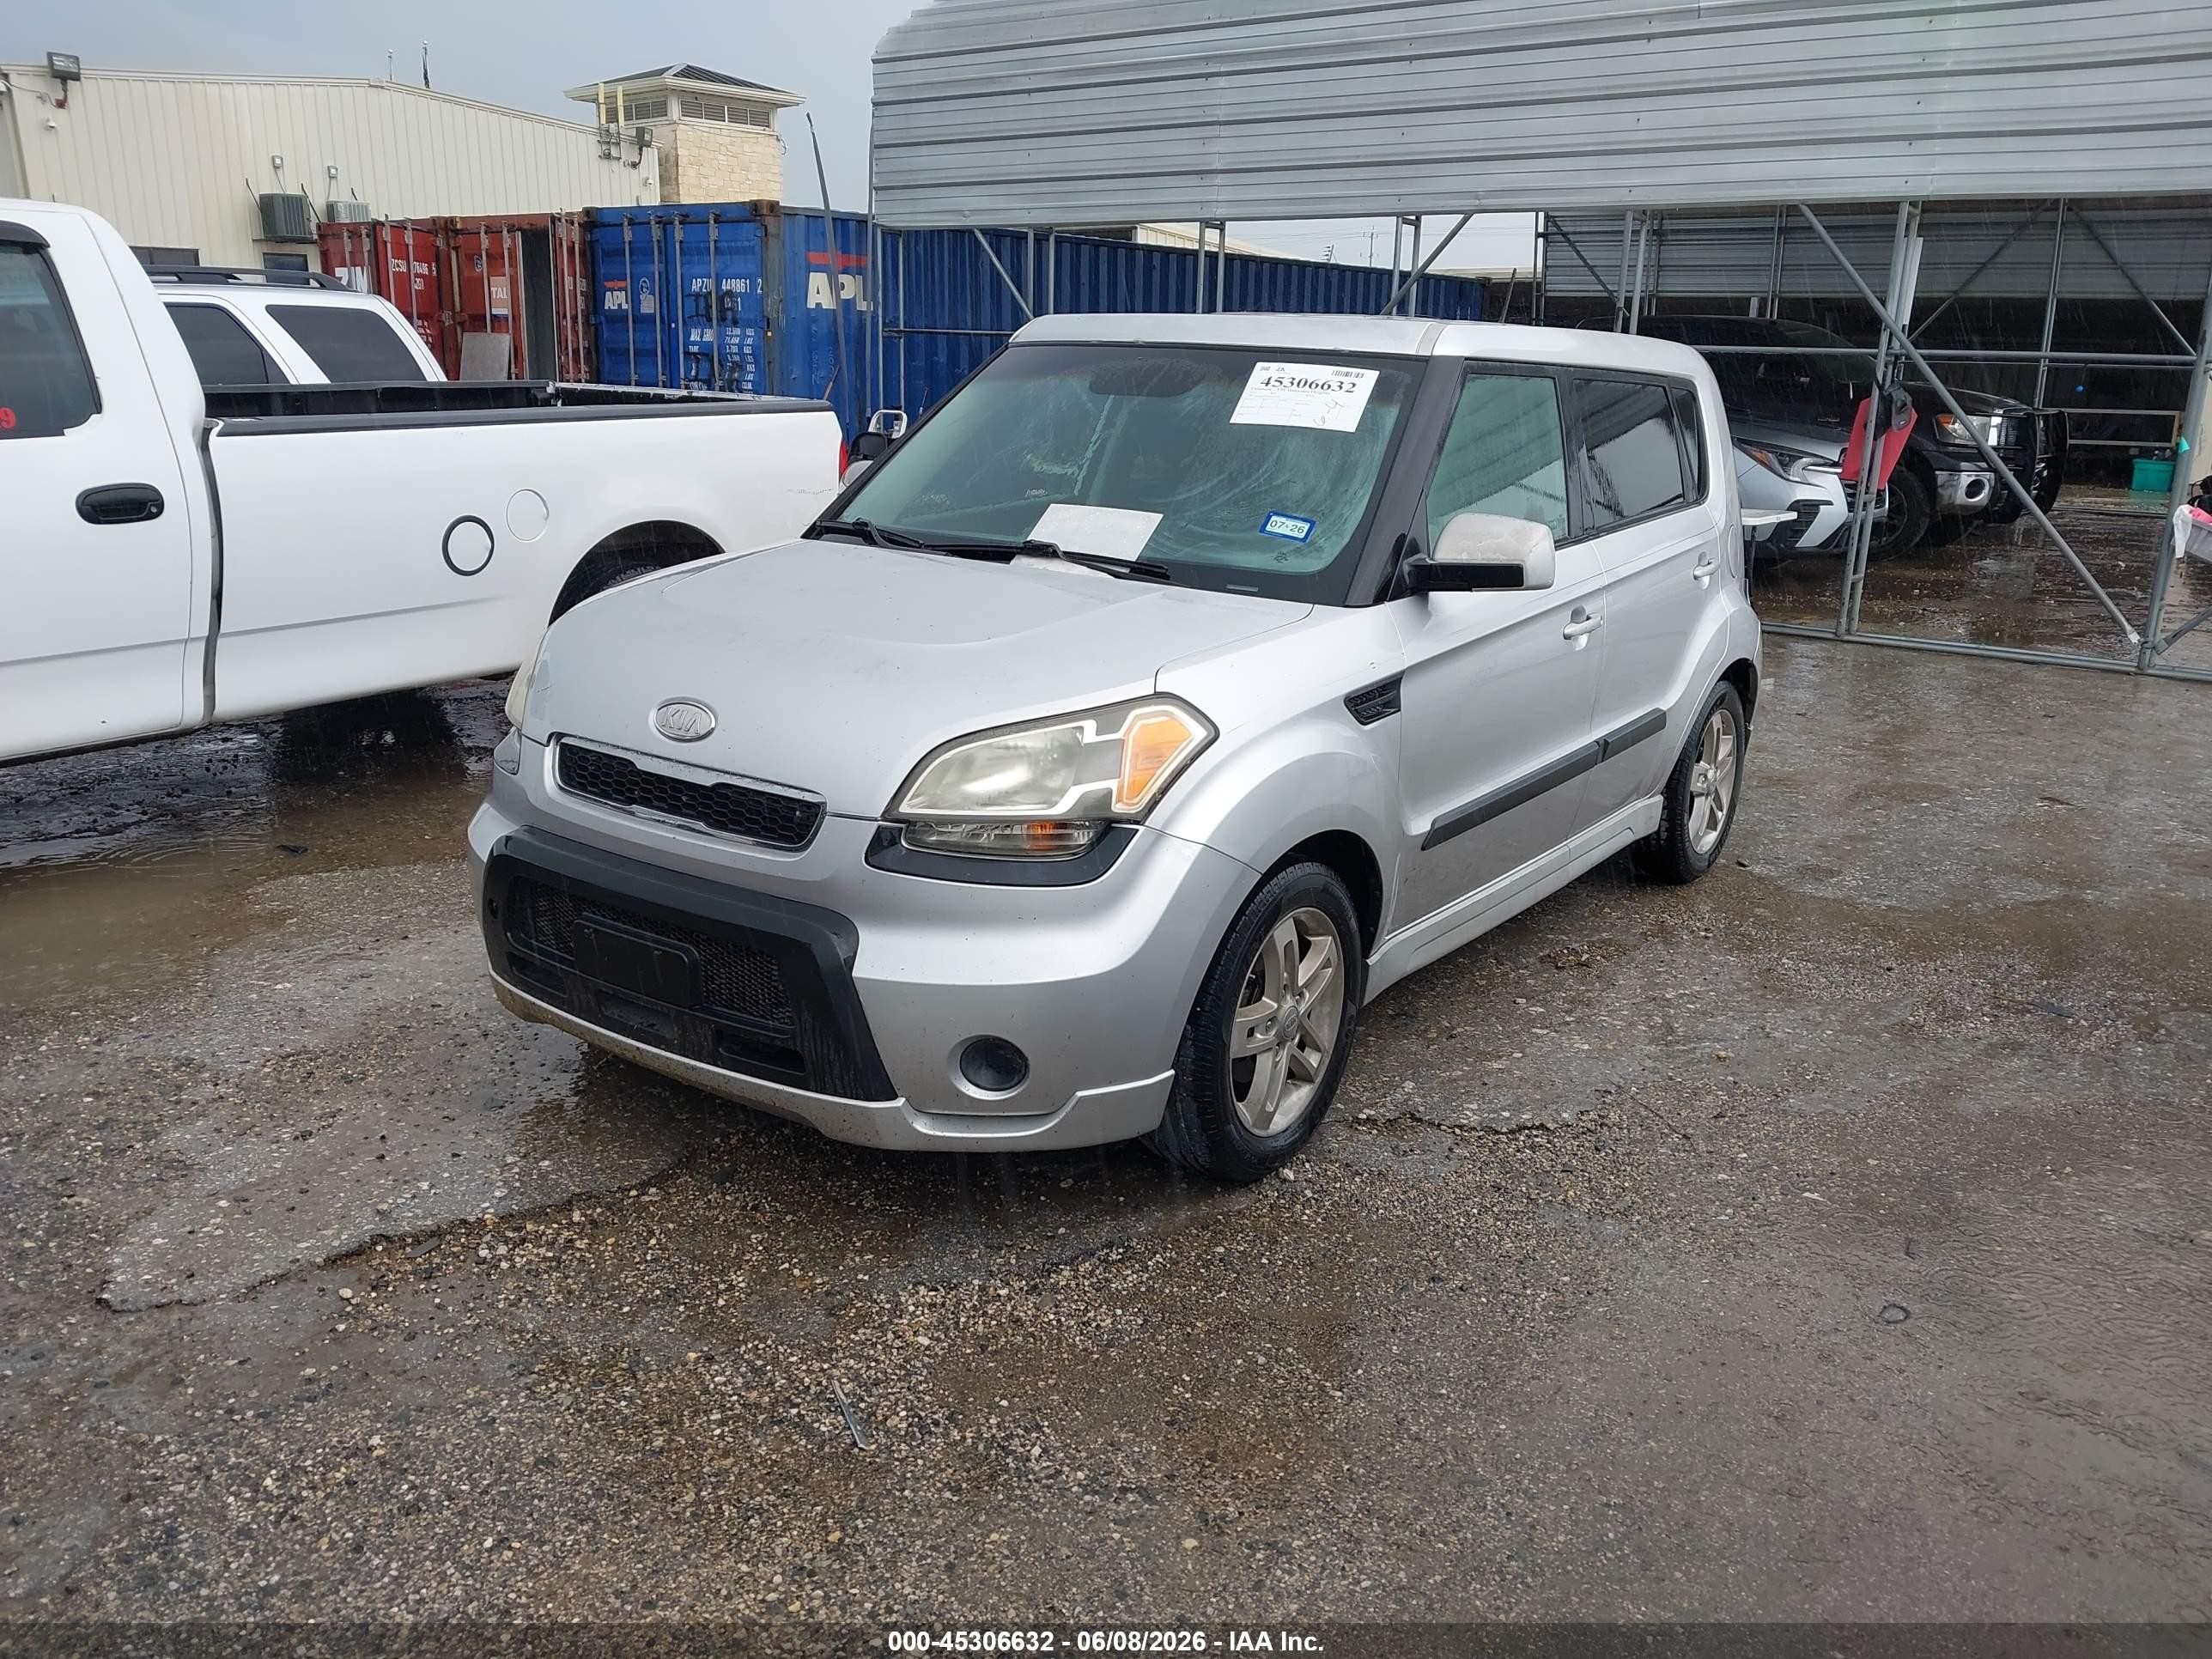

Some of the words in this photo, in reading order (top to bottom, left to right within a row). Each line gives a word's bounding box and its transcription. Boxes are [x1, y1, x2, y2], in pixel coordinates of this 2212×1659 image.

[490, 287, 508, 299] TAL
[691, 277, 712, 292] APZU
[721, 278, 750, 293] 448861
[807, 271, 873, 311] APL
[604, 290, 628, 309] APL
[1260, 375, 1357, 393] 45306632
[1269, 520, 1286, 529] 07
[1290, 524, 1306, 534] 26
[661, 706, 702, 735] KIA
